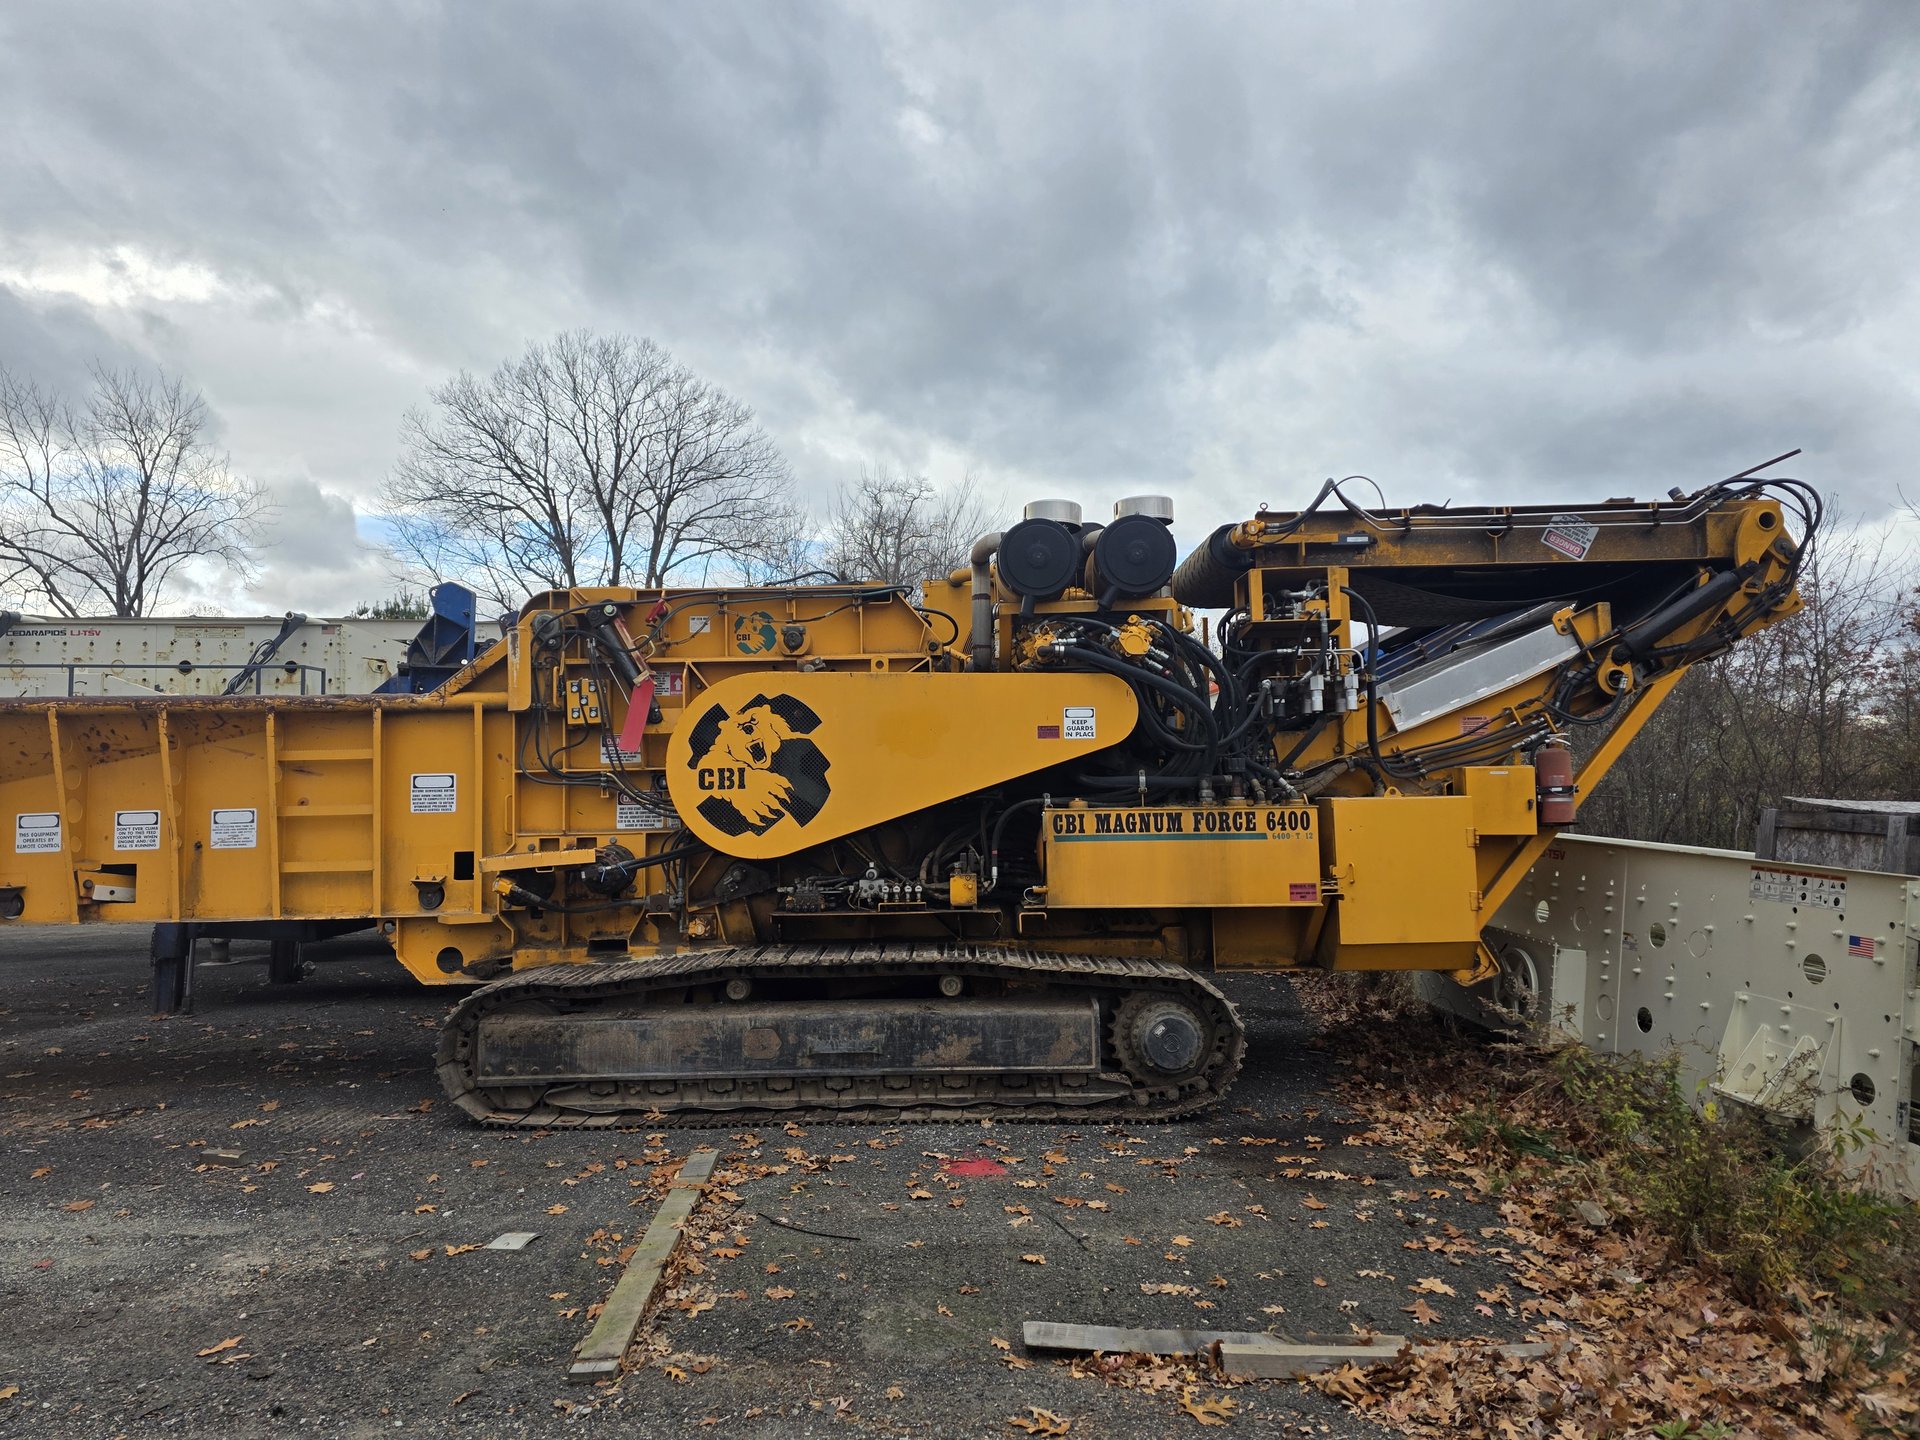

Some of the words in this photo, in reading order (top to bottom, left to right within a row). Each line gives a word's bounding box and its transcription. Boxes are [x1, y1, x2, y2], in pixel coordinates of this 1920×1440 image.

[1549, 534, 1581, 554] DANGER
[736, 633, 751, 641] CBI
[698, 767, 746, 790] CBI
[1053, 813, 1086, 834] CBI
[1095, 811, 1183, 834] MAGNUM
[1192, 810, 1257, 832] FORCE
[1266, 810, 1311, 831] 6400
